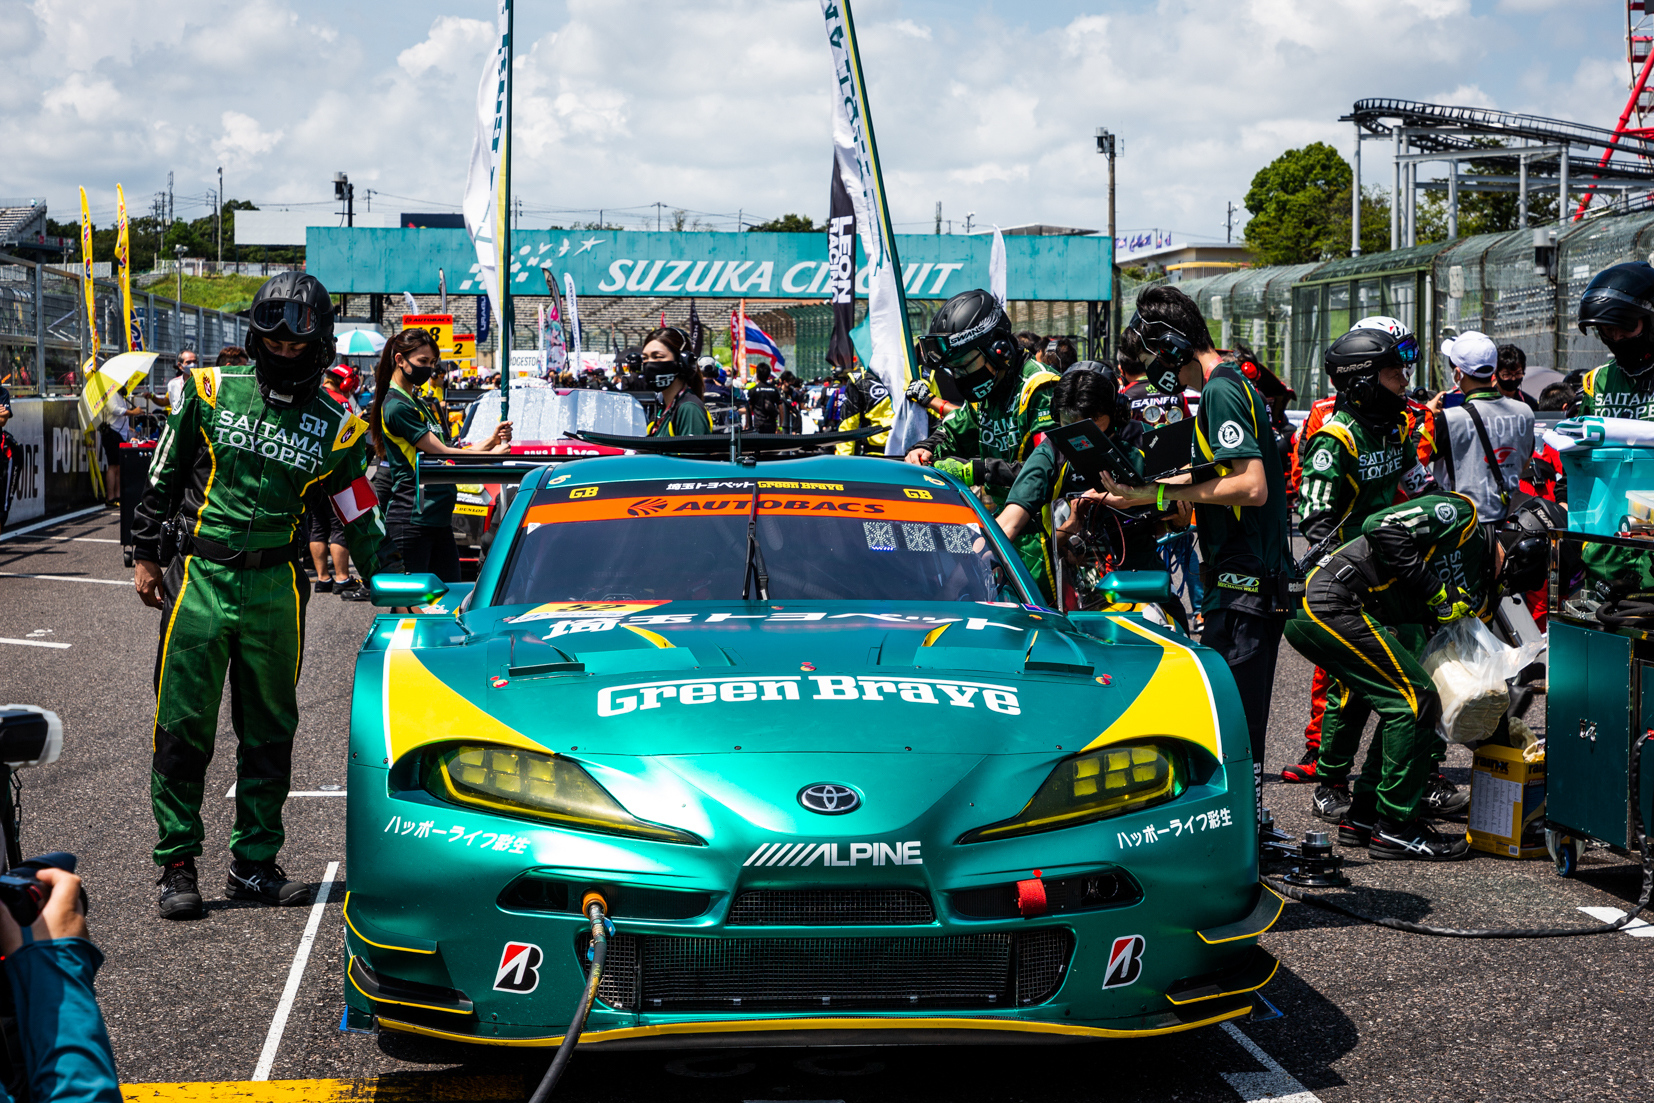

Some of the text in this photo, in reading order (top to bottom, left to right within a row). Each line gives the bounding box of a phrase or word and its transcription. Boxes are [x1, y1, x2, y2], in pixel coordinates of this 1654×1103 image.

[838, 216, 853, 304] LEON
[599, 259, 963, 294] SUZUKA CICIT
[950, 326, 985, 345] SWANS
[1595, 392, 1654, 406] SAITAM
[218, 410, 323, 458] SAITAMA
[300, 413, 327, 437] GB
[1466, 414, 1526, 440] PHOTO
[215, 427, 322, 474] TOYOPET
[1359, 446, 1402, 467] SAITAM
[1358, 457, 1402, 480] TOYOPE
[569, 487, 599, 499] GB
[666, 482, 755, 490] 埼玉トヨペット
[757, 481, 844, 491] Green Brave
[903, 488, 933, 500] GB
[1405, 474, 1422, 490] 52
[672, 500, 885, 513] AUTOBACS
[1450, 550, 1468, 590] SAIT
[542, 612, 1024, 640] 埼玉トヨペット
[597, 676, 1021, 717] Green Brave
[384, 816, 531, 854] ハッポーライフ彩生
[1117, 808, 1232, 849] ハッポーライフ彩生
[775, 841, 923, 866] ALPINE
